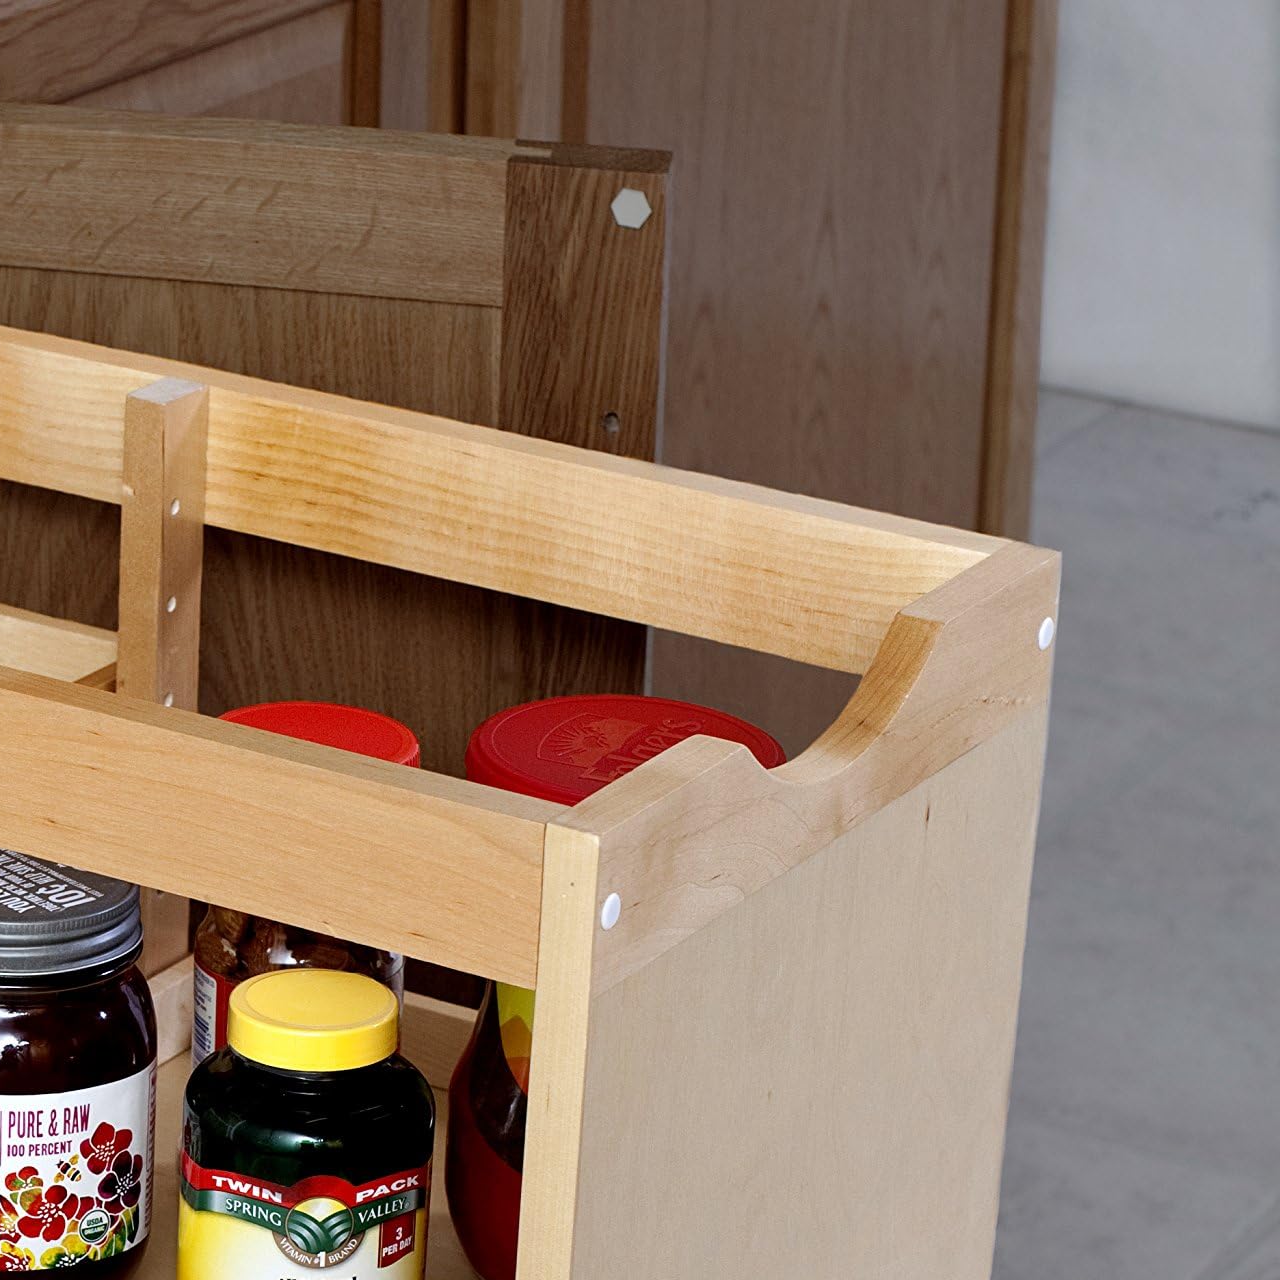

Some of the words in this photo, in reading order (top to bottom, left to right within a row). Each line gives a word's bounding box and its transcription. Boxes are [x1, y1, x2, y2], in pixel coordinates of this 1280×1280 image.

[0, 897, 35, 912] YOU
[8, 1110, 44, 1139] PURE
[48, 1109, 58, 1137] &
[63, 1103, 91, 1135] RAW
[7, 1143, 25, 1158] 100
[28, 1140, 72, 1158] PERCENT
[212, 1175, 283, 1204] TWIN
[355, 1175, 419, 1203] PACK
[86, 1216, 104, 1227] USDA
[225, 1197, 282, 1228] SPRING
[395, 1227, 403, 1241] 3
[280, 1237, 313, 1265] VITAMIN
[328, 1238, 358, 1264] BRAND
[382, 1244, 398, 1257] PER
[400, 1236, 413, 1250] DAY
